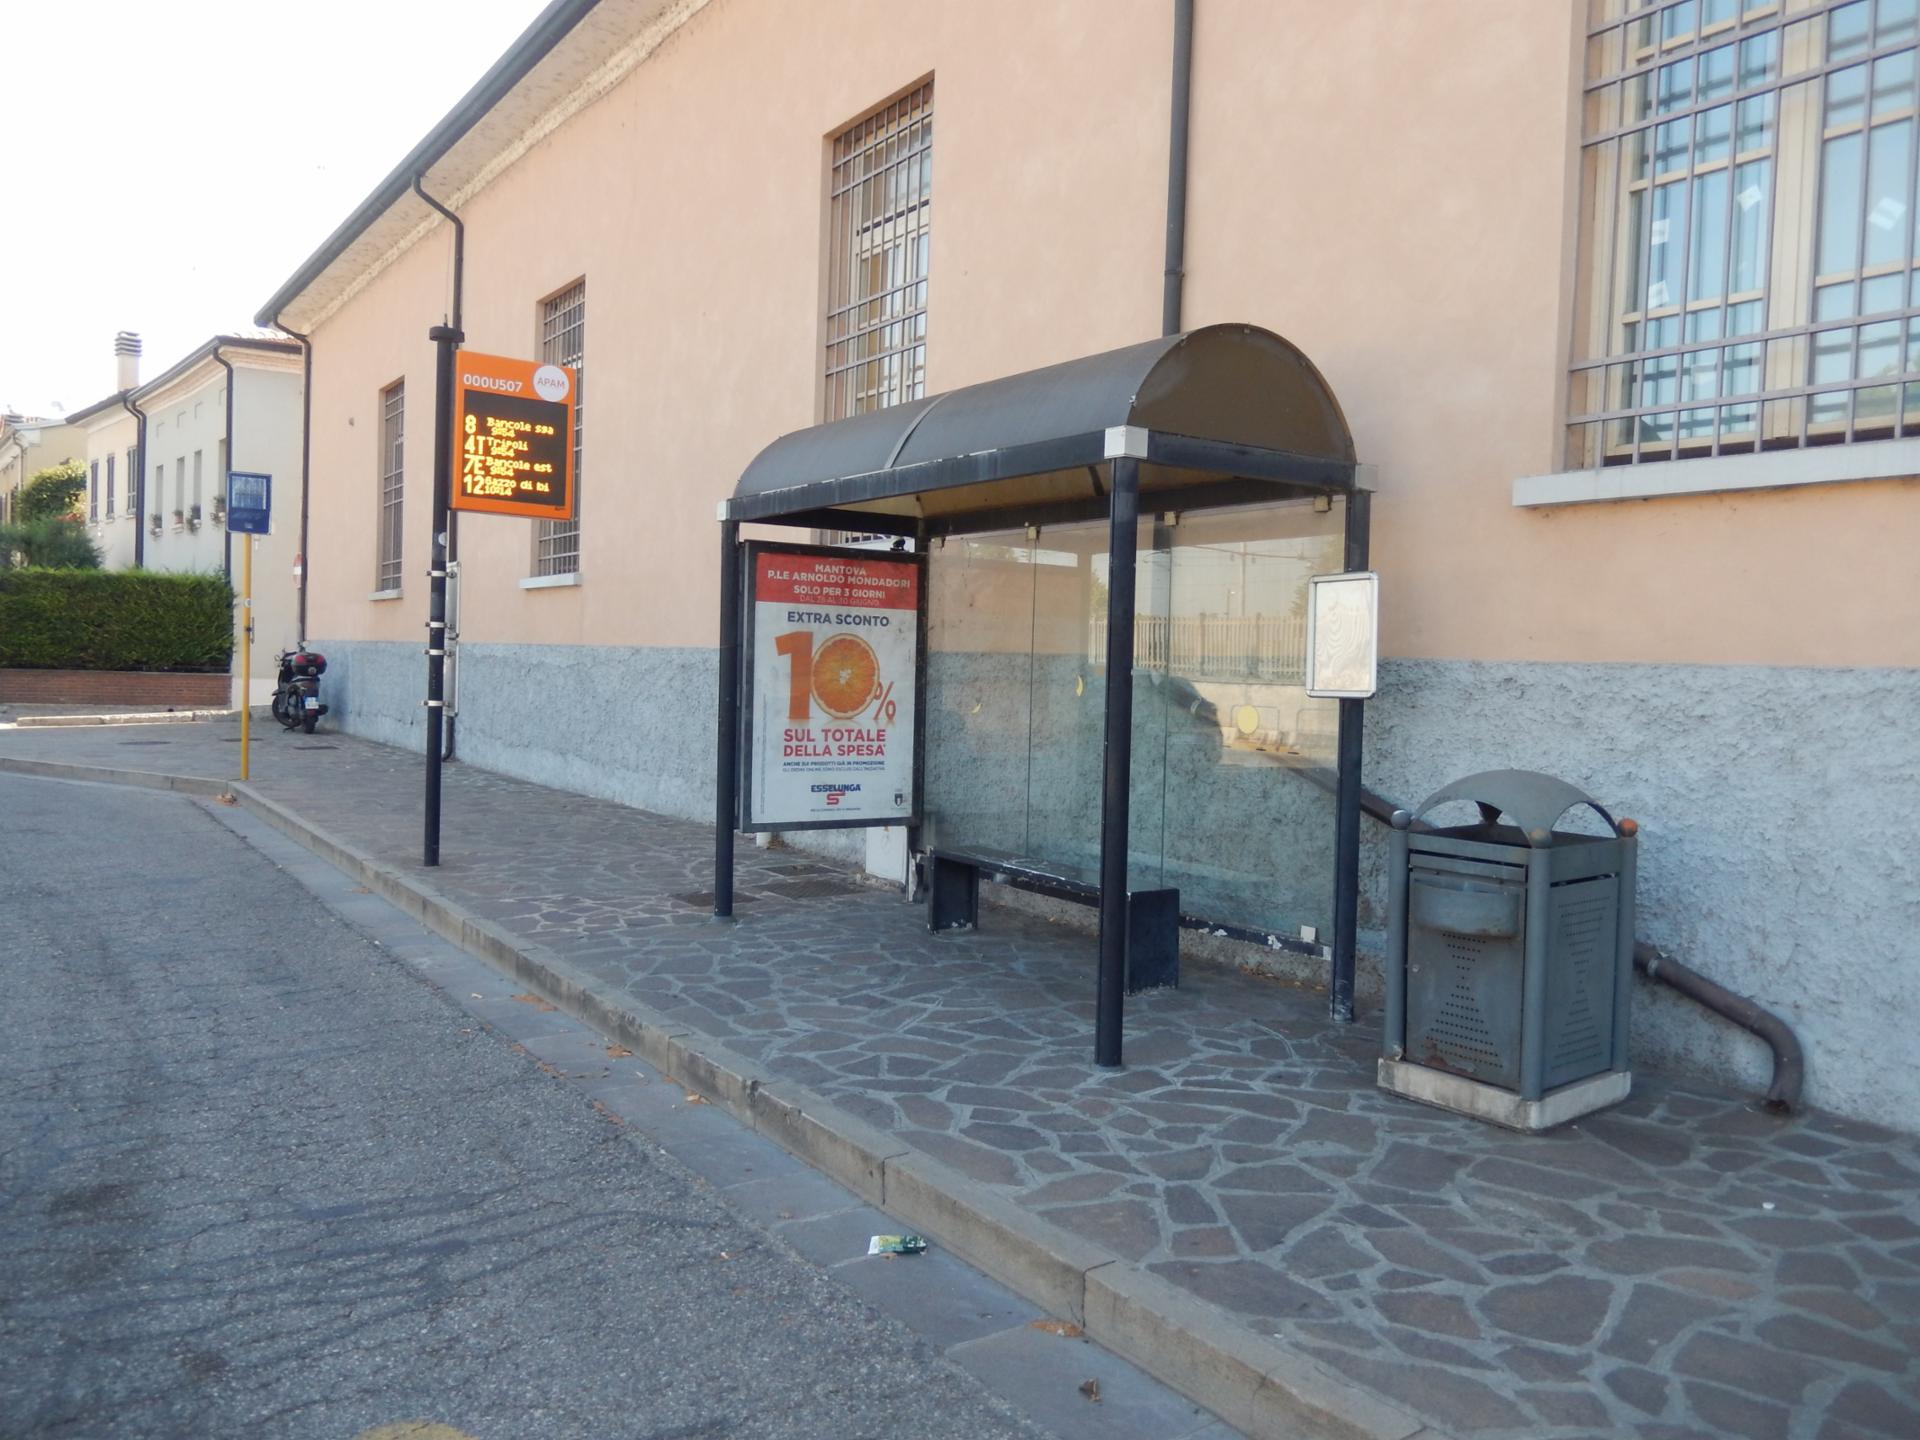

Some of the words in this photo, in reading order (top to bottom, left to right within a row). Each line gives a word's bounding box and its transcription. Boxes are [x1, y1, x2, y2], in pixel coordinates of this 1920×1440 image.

[537, 377, 565, 389] APAM
[465, 414, 477, 434] 8
[487, 417, 532, 431] Bancole
[464, 434, 486, 455] 4T
[487, 436, 528, 451] Tripoli
[463, 453, 485, 475] 7E
[485, 456, 531, 471] Bancole
[533, 463, 552, 473] est
[463, 474, 485, 495] 12
[520, 480, 533, 490] di
[815, 563, 867, 576] MANTOVA
[767, 569, 790, 580] P.LE
[792, 571, 845, 584] ARNOLDO
[847, 576, 911, 588] MONDADORI
[793, 585, 821, 595] SOLO
[822, 587, 842, 597] PER
[843, 588, 850, 597] 3
[851, 589, 886, 599] GIORNI
[787, 611, 832, 625] EXTRA
[835, 614, 890, 627] SCONTO
[783, 728, 815, 742] SUL
[821, 728, 886, 742] TOTALE
[783, 744, 832, 757] DELLA
[810, 784, 861, 793] ESSELUNGA
